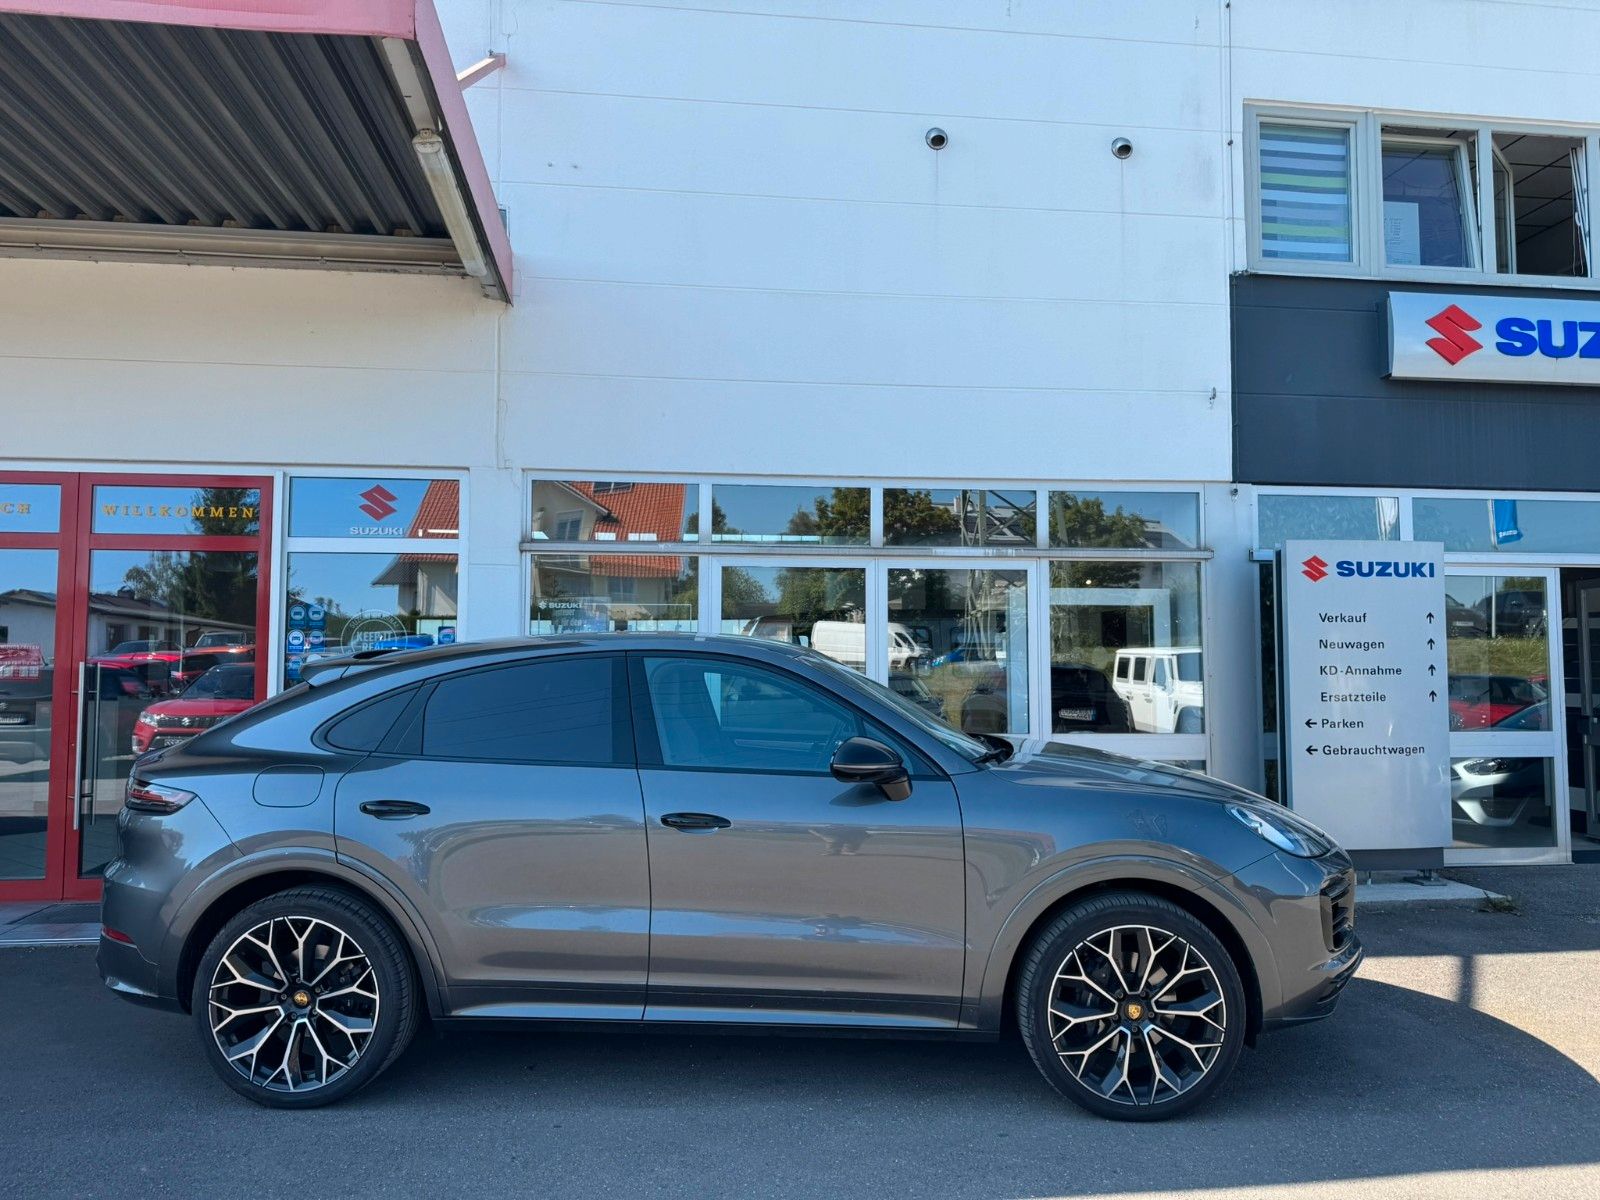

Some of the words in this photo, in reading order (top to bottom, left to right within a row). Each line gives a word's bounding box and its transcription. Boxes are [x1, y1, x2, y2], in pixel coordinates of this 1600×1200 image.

[102, 503, 254, 518] WILLKOMMEN
[349, 526, 403, 535] SUZUKI
[1336, 560, 1435, 578] SUZUKI
[1319, 612, 1367, 623] Verkauf
[1319, 639, 1385, 652] Neuwagen
[1319, 665, 1402, 676] KD-Annahme
[1320, 691, 1386, 703] Ersatzteile
[1321, 718, 1364, 729] Parken
[1322, 744, 1425, 757] Gebrauchtwagen
